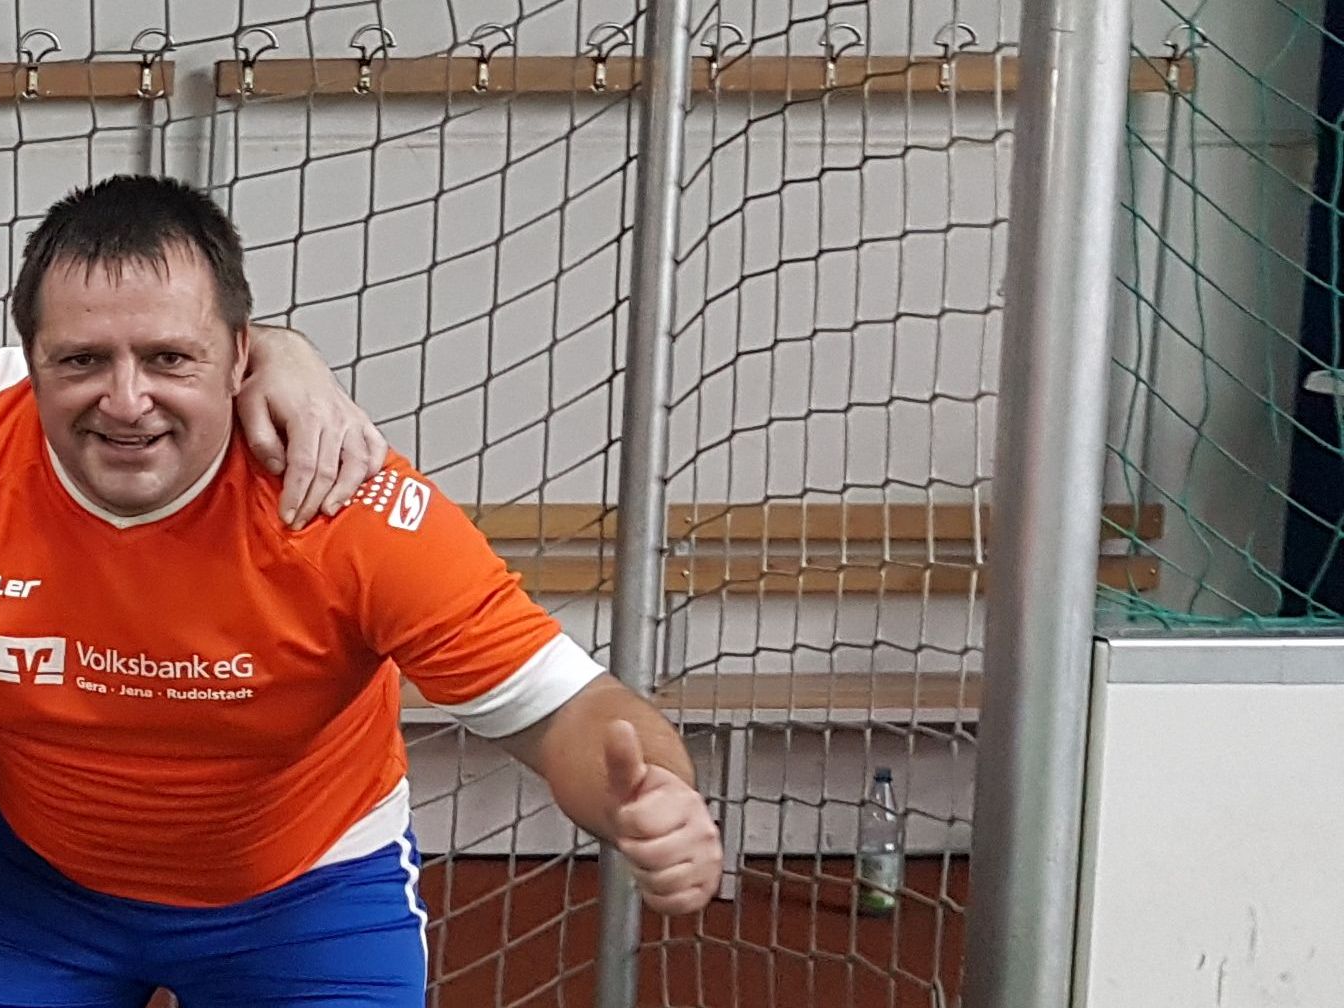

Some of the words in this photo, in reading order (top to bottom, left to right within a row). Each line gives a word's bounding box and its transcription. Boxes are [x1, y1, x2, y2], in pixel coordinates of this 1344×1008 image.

[76, 641, 211, 679] Volksbank
[213, 653, 254, 679] eG
[76, 676, 108, 695] Gera
[119, 684, 154, 698] Jena
[167, 687, 254, 701] Rudolstadt
